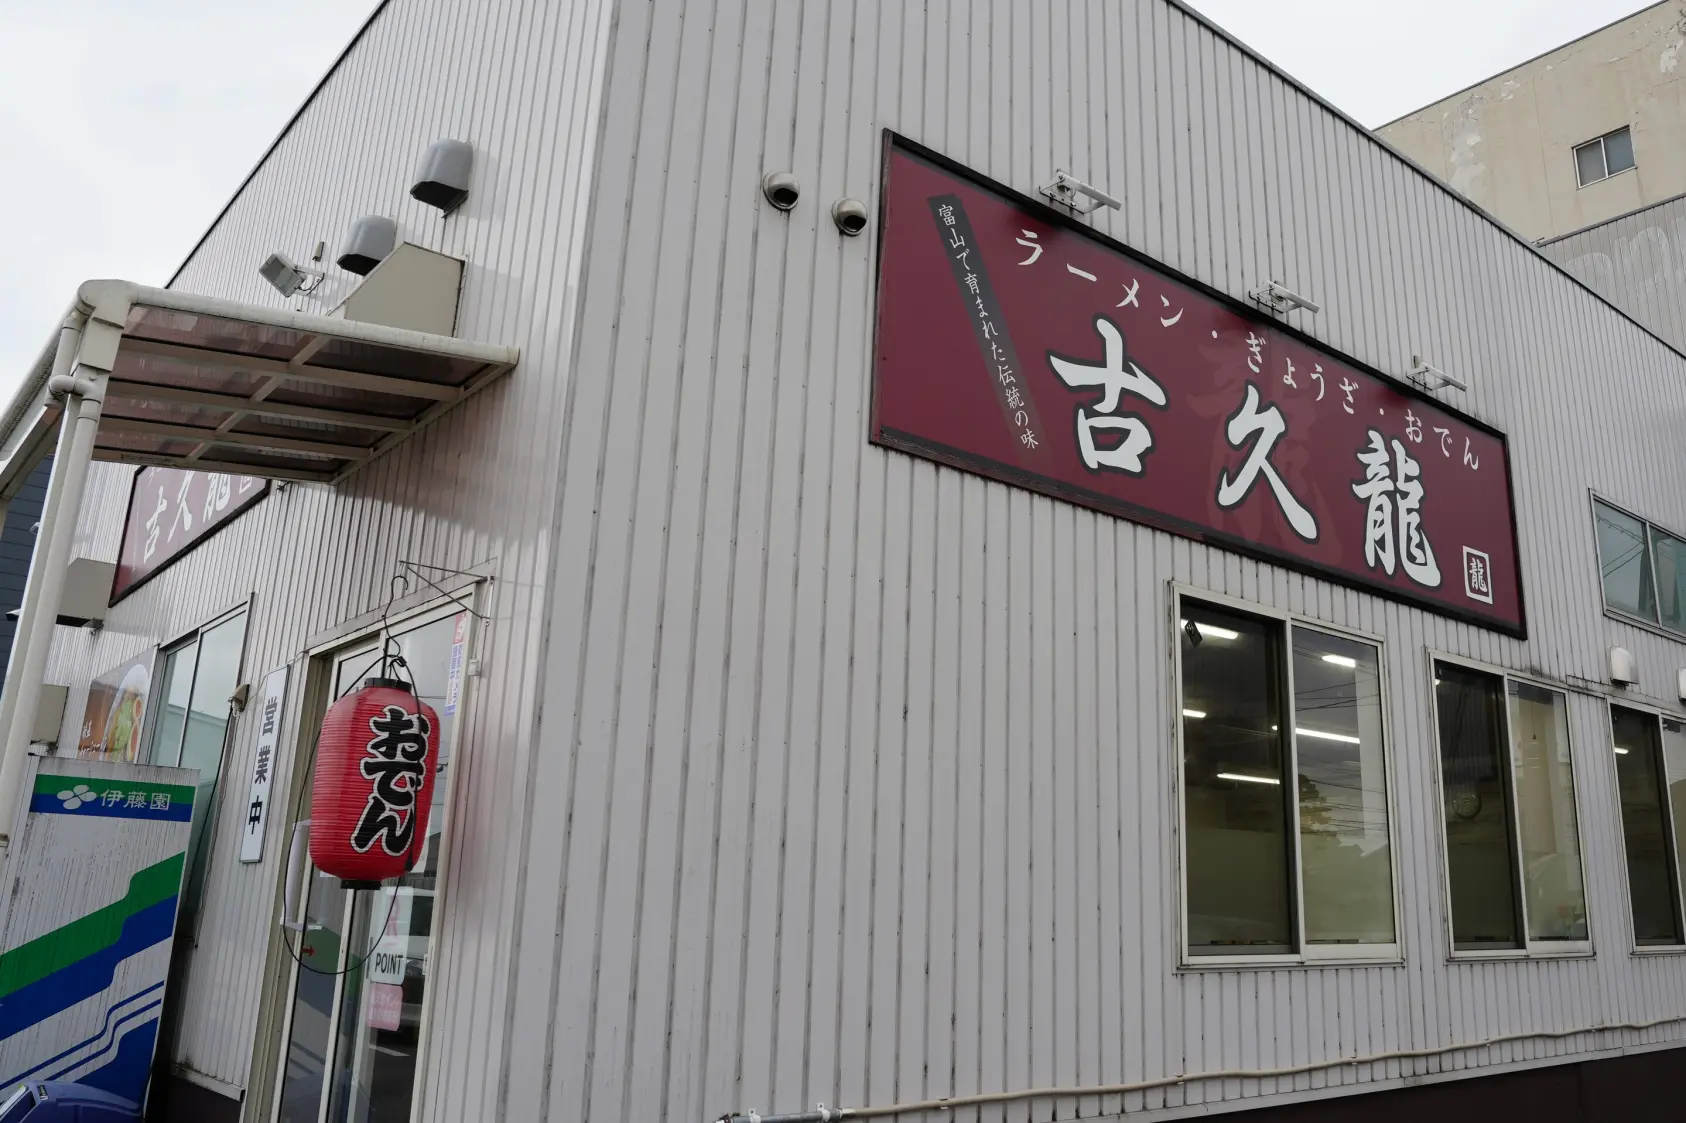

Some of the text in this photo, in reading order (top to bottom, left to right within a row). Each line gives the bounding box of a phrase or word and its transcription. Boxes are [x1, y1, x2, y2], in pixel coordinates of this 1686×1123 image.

[938, 203, 1040, 450] 富山で育まれた伝統の味
[1015, 228, 1480, 471] ラーメン・ぎょうざ・おでん
[100, 788, 171, 811] 伊藤園
[248, 696, 279, 835] 営業中
[351, 705, 431, 856] おでん
[374, 952, 404, 976] POINT
